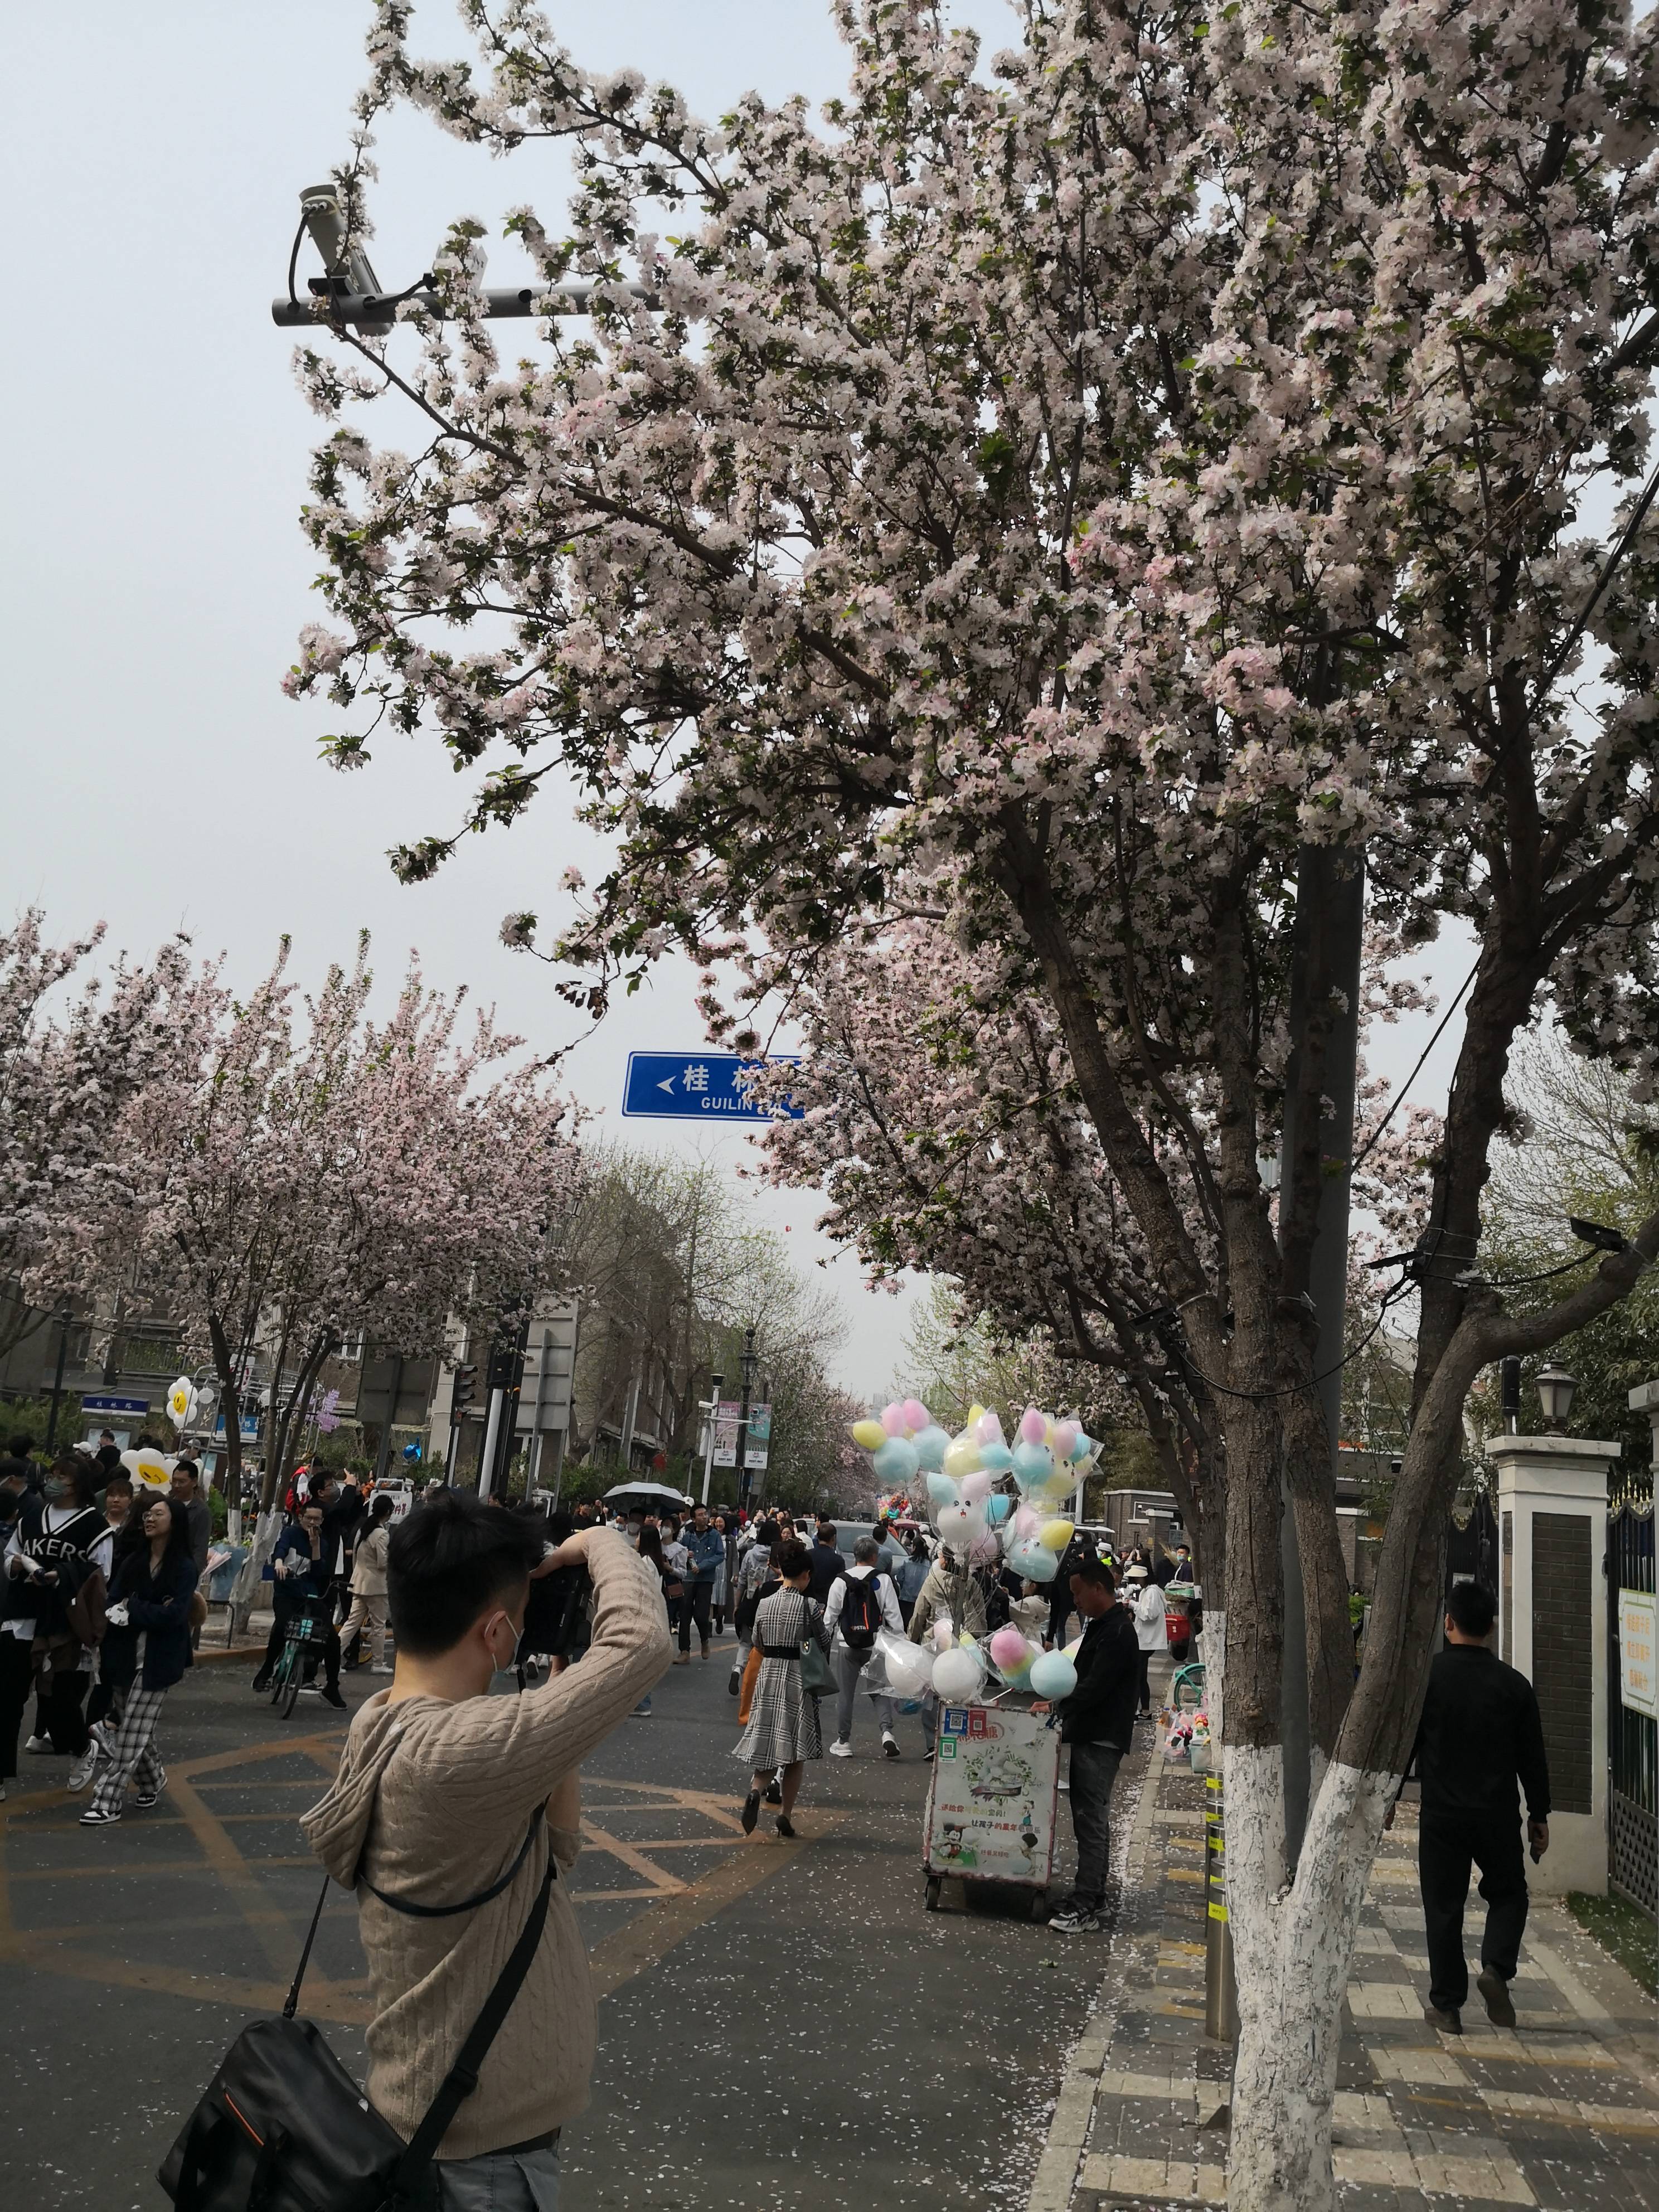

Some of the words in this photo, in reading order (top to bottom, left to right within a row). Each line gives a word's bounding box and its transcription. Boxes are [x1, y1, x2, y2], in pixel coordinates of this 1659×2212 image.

[701, 1097, 753, 1110] GUILIN
[96, 1400, 133, 1410] 桂林路
